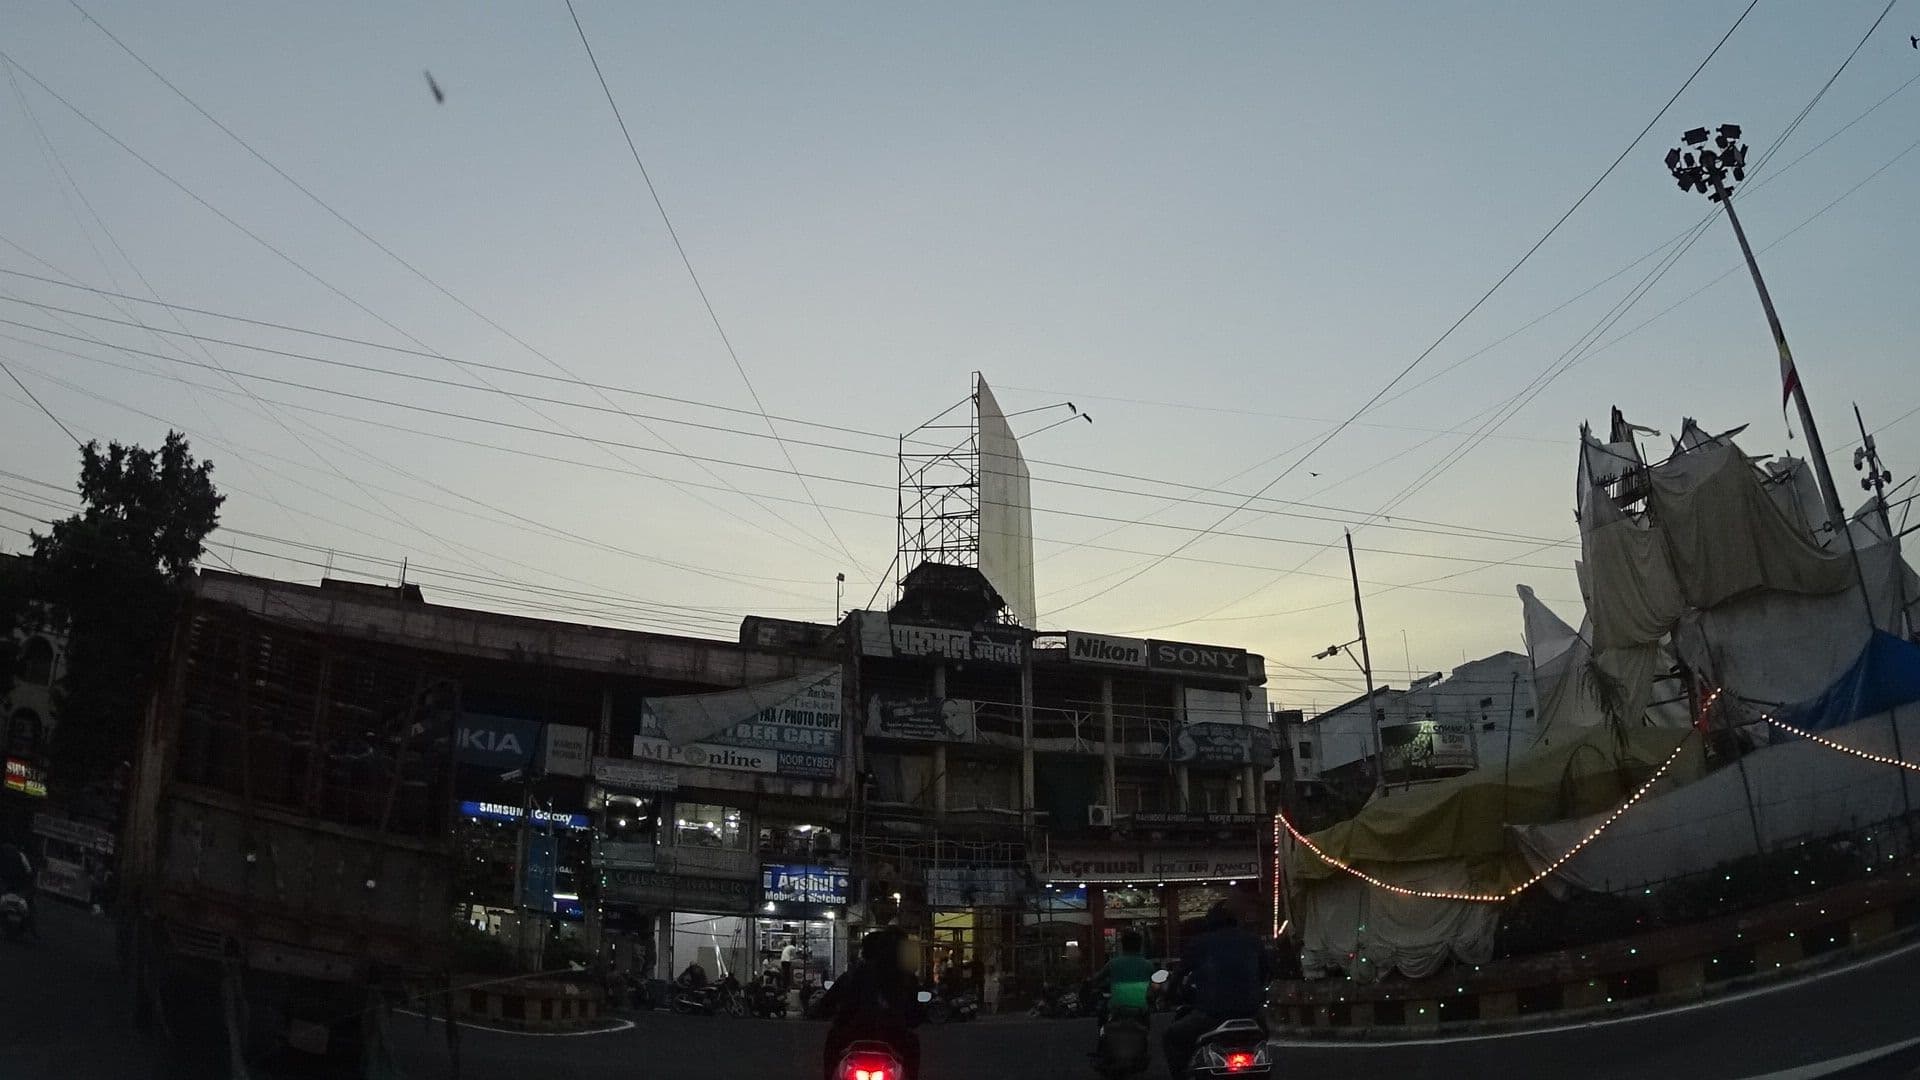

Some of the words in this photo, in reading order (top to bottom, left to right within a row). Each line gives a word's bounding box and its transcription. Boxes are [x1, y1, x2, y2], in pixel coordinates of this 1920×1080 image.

[1075, 637, 1139, 663] Nikon
[1158, 645, 1239, 668] SONY
[785, 709, 814, 727] PHOTO
[816, 711, 840, 729] COPY
[641, 742, 682, 760] MP
[780, 752, 804, 766] NOOR
[805, 755, 834, 769] CYBER
[479, 802, 534, 818] SAMSUN
[808, 892, 847, 904] Watches
